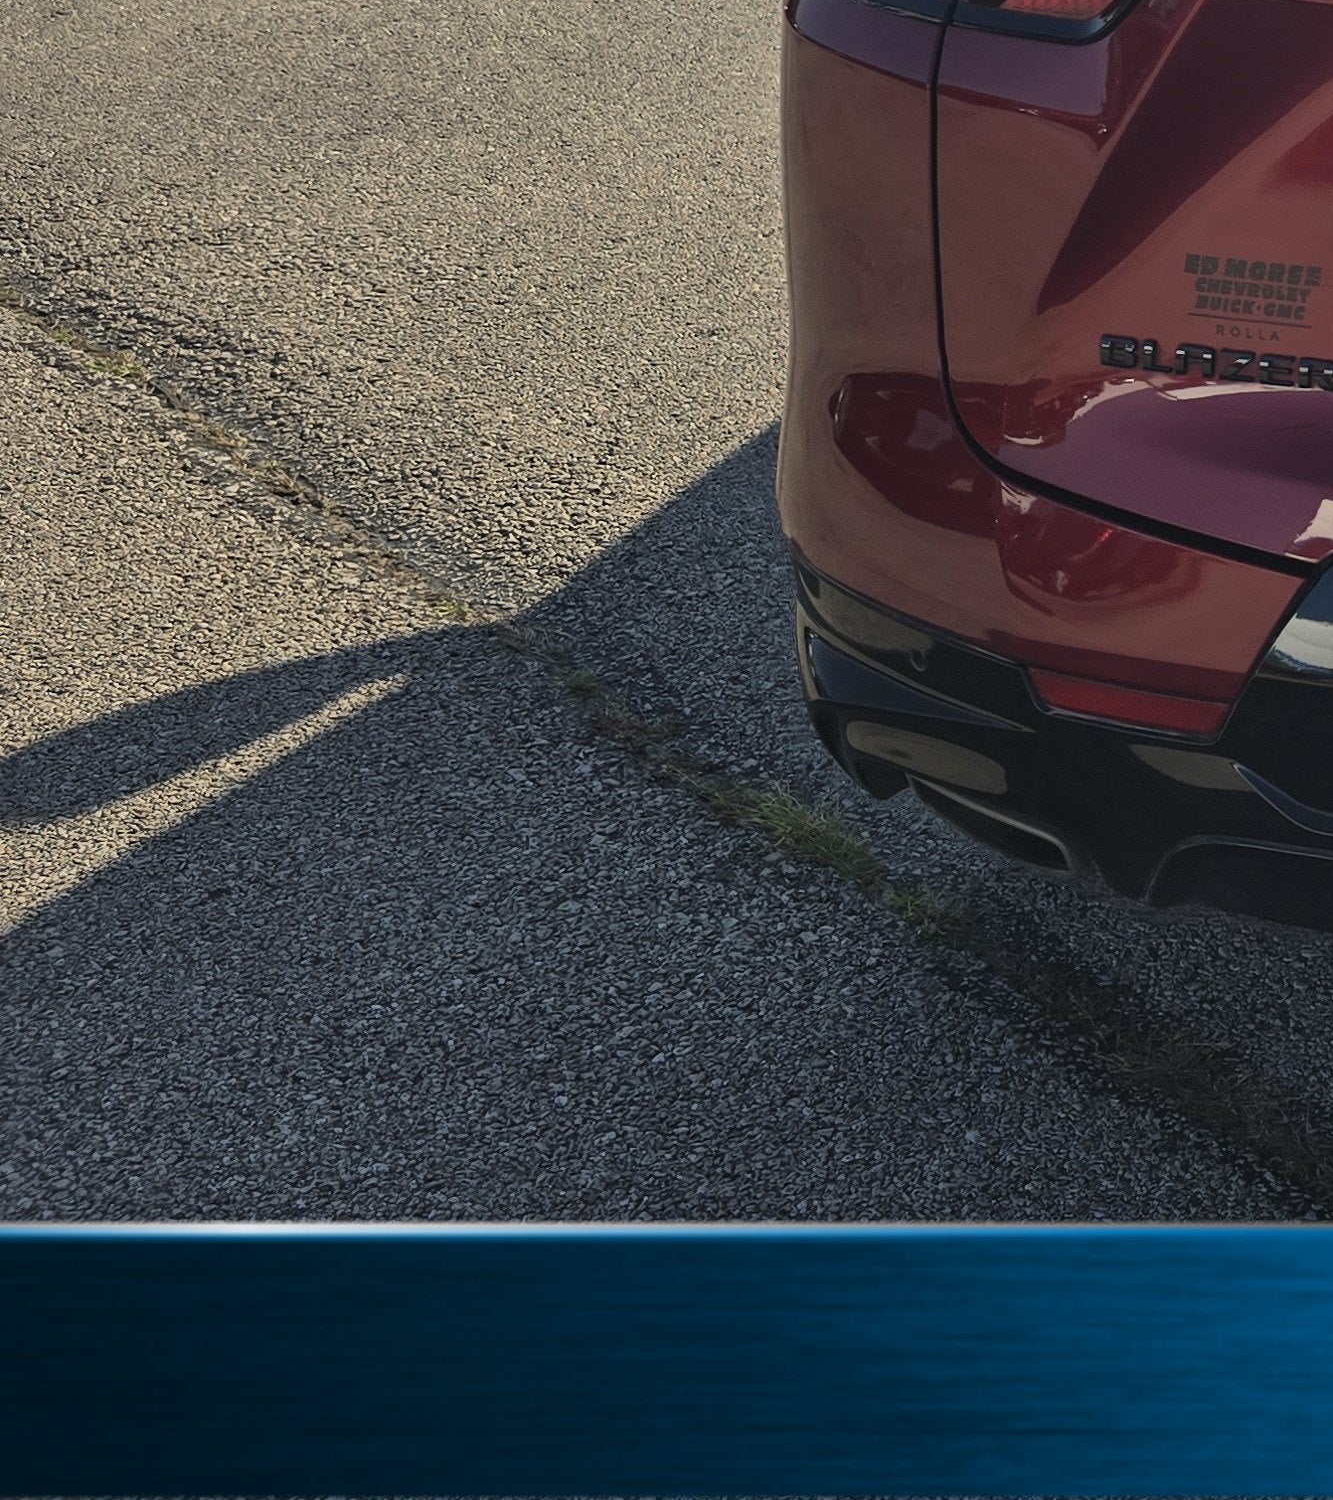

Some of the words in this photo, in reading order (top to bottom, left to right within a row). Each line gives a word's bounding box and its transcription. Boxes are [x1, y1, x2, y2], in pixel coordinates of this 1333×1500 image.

[1184, 253, 1219, 275] ED
[1224, 258, 1323, 287] MORSE
[1195, 277, 1311, 303] CHEVROLET
[1216, 324, 1280, 342] ROLLA
